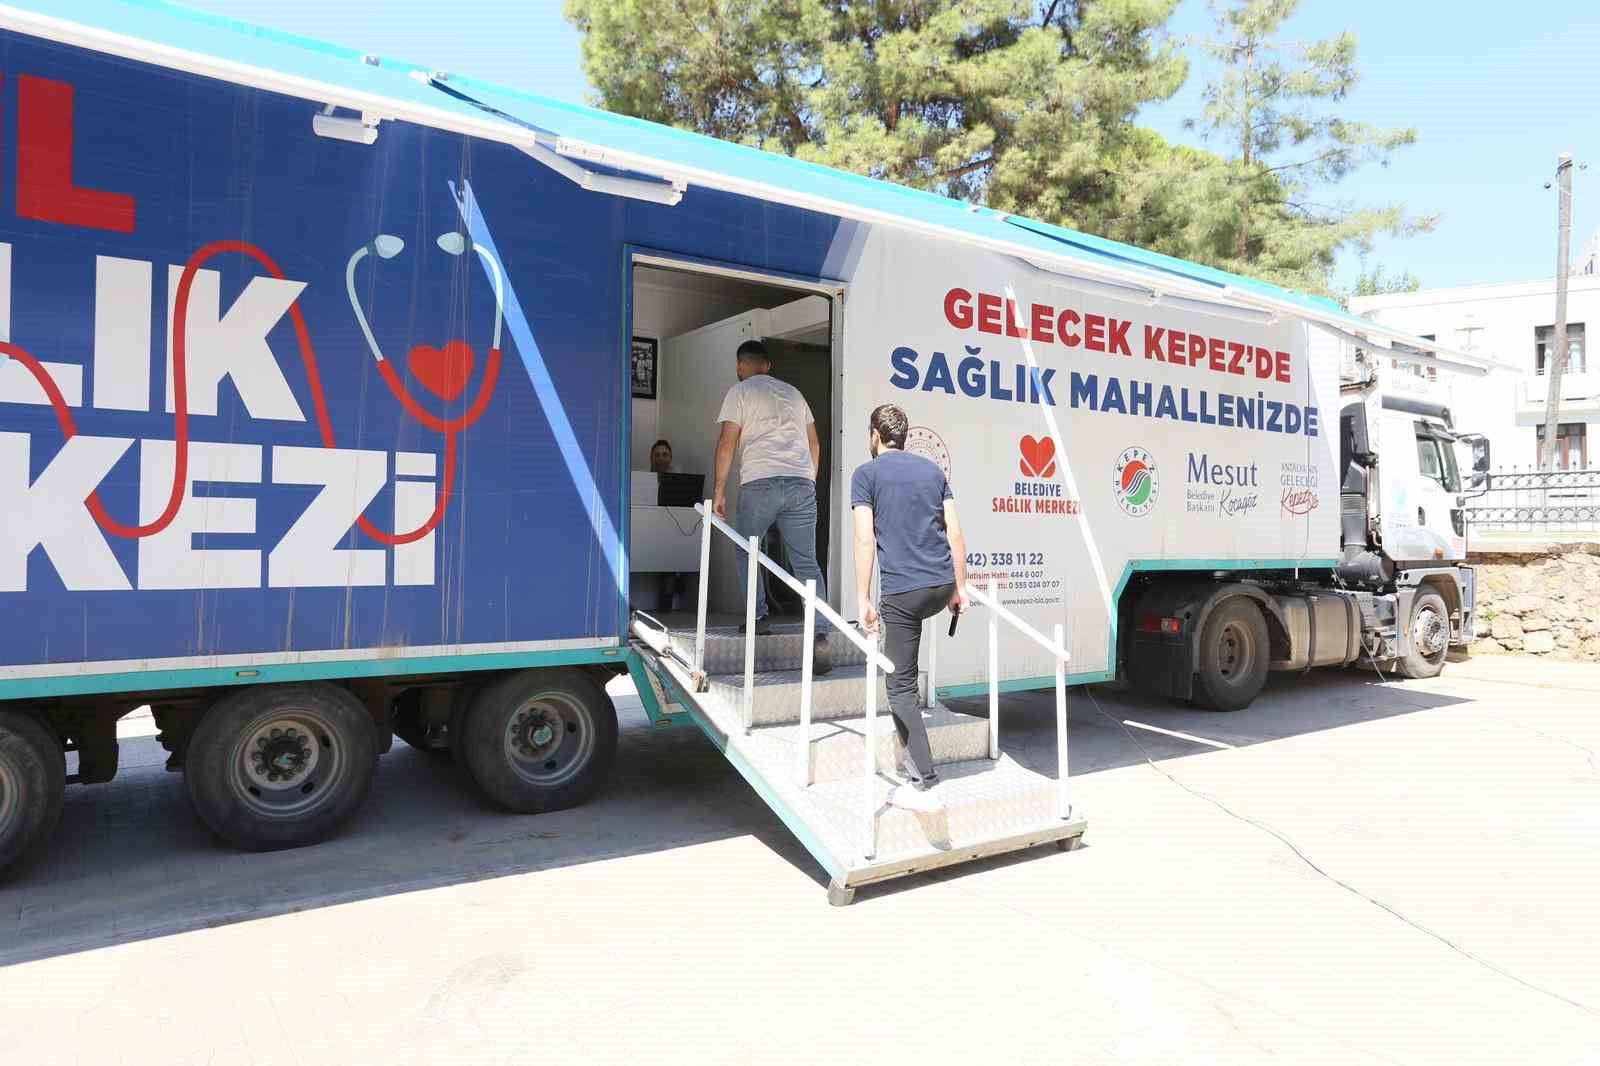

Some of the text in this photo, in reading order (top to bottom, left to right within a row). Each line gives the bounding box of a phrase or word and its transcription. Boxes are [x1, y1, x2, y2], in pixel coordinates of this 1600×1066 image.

[0, 73, 135, 233] L
[943, 287, 1291, 383] GELECEK KEPEZ'DE
[889, 344, 1318, 437] SAĞLIK MAHALLENİZDE
[1187, 452, 1258, 487] Mesut
[992, 495, 1032, 513] SAĞLIK
[991, 552, 1013, 566] 338
[1016, 552, 1026, 565] 11
[1029, 552, 1044, 565] 22
[1008, 582, 1014, 590] 0
[1042, 581, 1050, 589] 07
[1051, 580, 1060, 588] 07
[1030, 570, 1044, 578] 007
